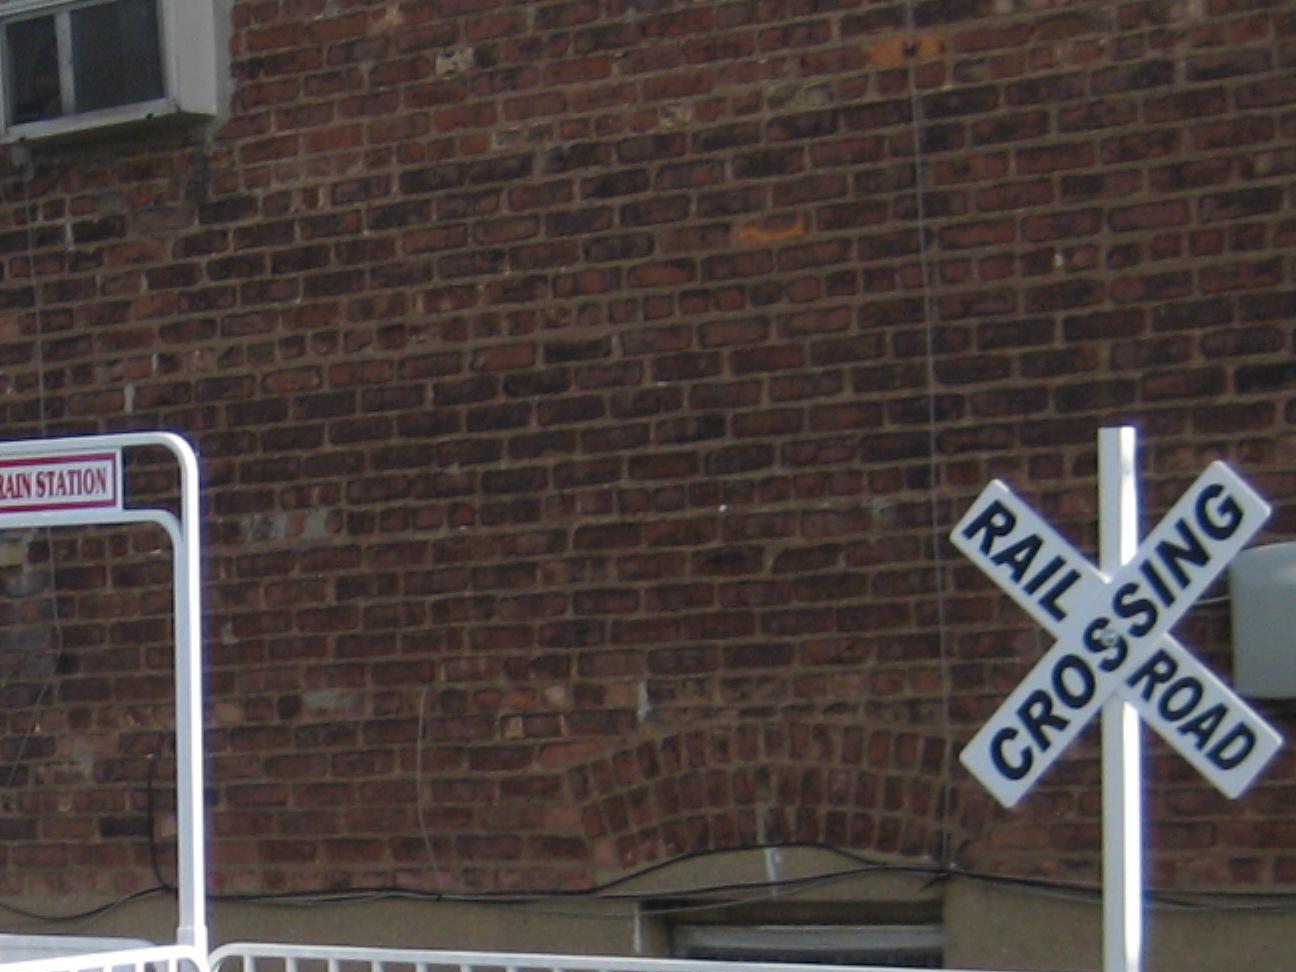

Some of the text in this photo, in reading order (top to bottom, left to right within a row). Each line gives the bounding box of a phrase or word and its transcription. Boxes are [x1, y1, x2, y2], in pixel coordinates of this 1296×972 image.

[35, 467, 107, 498] STATION
[962, 500, 1081, 622] RAIL
[989, 483, 1245, 782] CROSSING
[1126, 649, 1257, 771] ROAD
